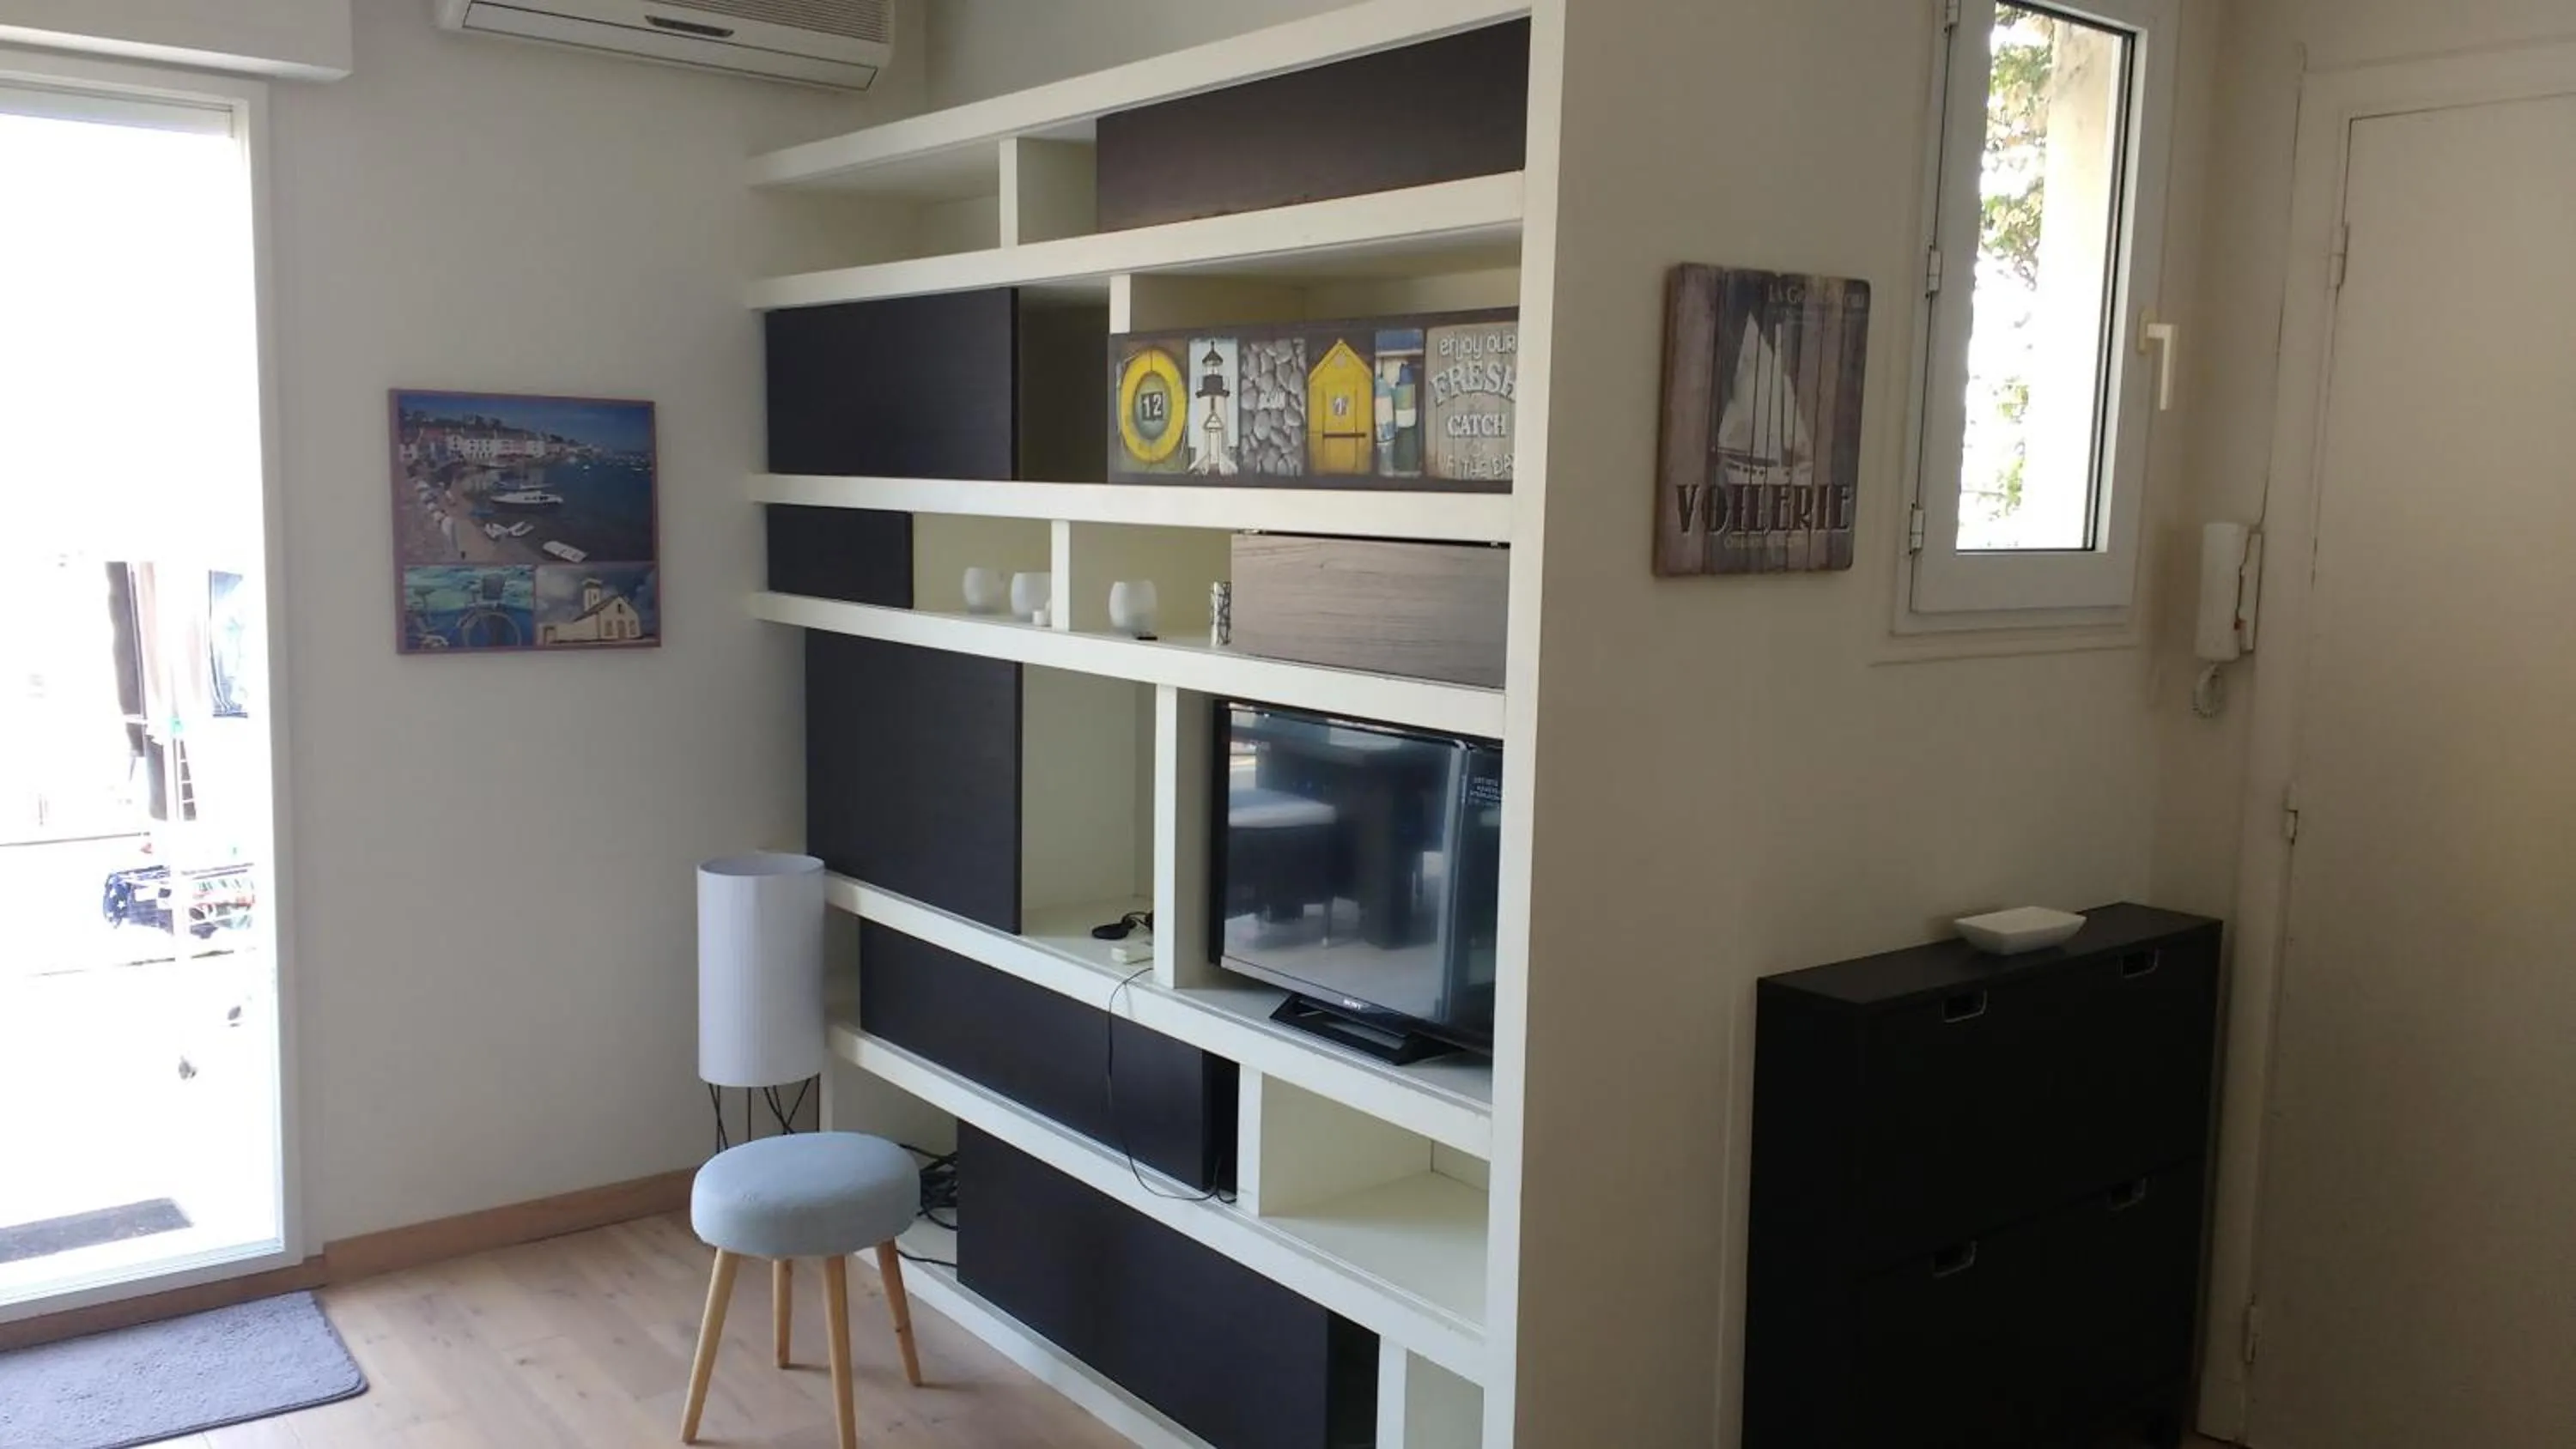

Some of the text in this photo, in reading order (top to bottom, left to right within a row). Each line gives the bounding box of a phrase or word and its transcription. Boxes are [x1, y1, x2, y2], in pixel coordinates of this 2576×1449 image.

[1430, 360, 1516, 406] FRESH
[1143, 394, 1162, 418] 12
[1447, 413, 1507, 436] CATCH
[1676, 483, 1853, 534] VOILERIE
